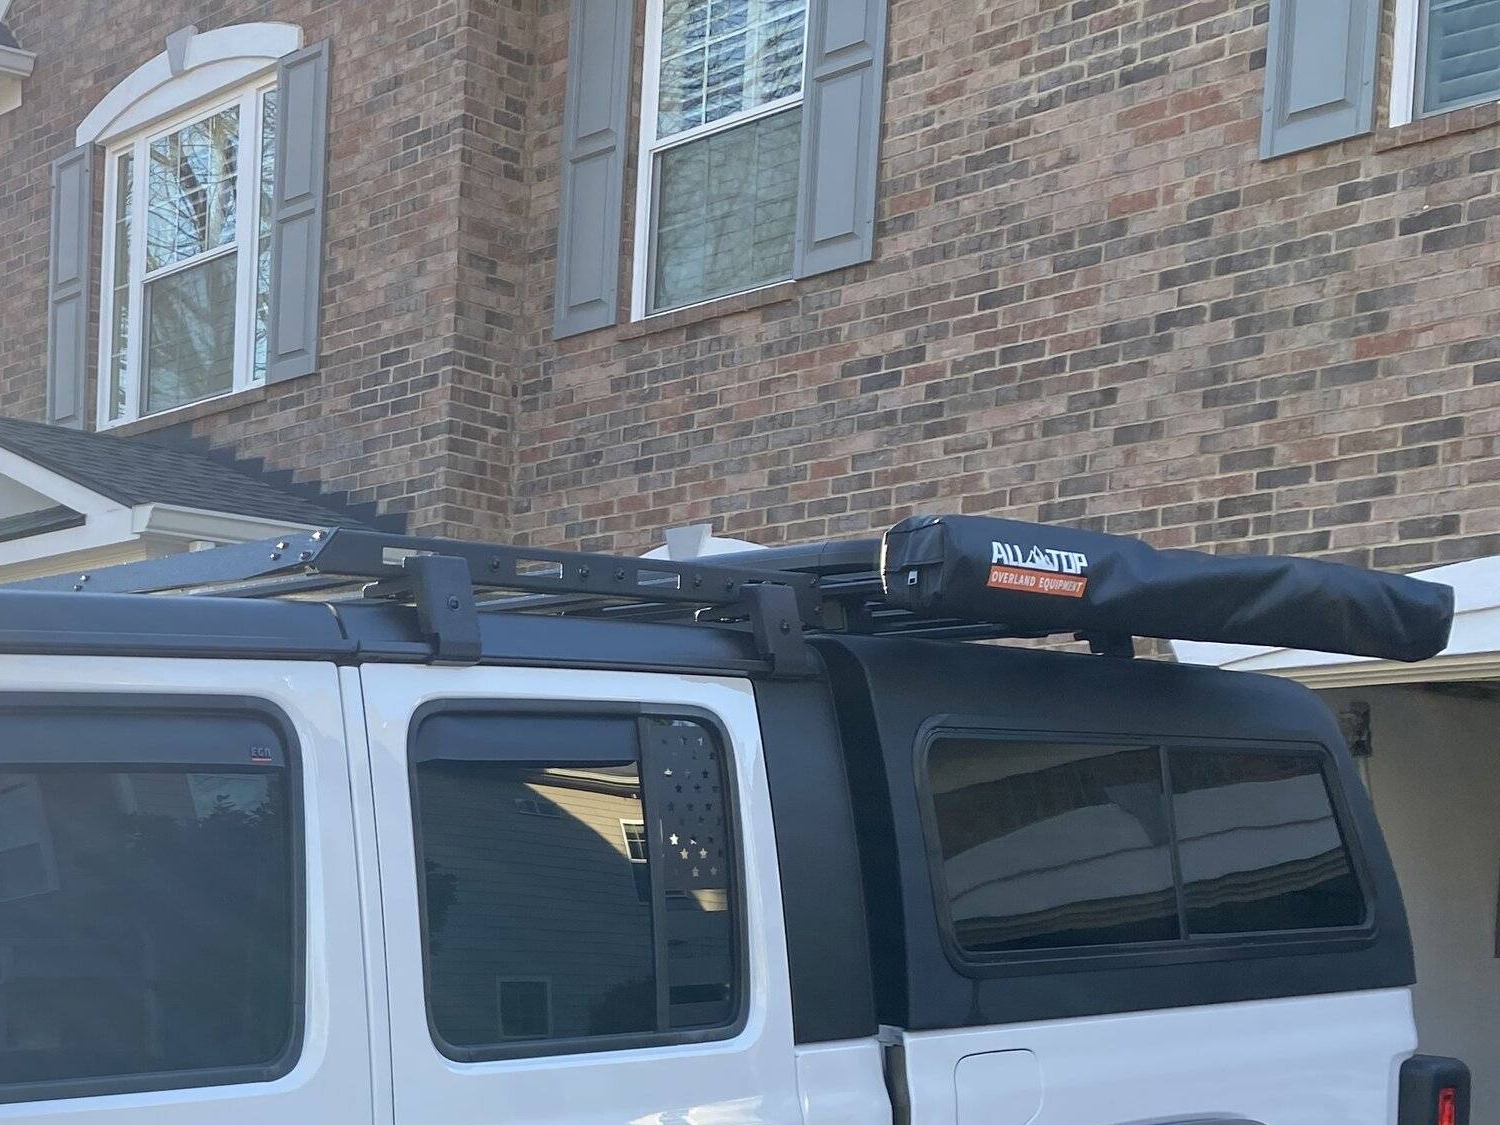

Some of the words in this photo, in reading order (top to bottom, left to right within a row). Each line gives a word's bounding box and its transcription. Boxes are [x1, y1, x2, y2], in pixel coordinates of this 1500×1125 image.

[992, 541, 1029, 567] ALL
[1045, 548, 1089, 574] TOP
[991, 571, 1036, 586] OVERLAND
[1039, 576, 1083, 593] EQUIPMENT
